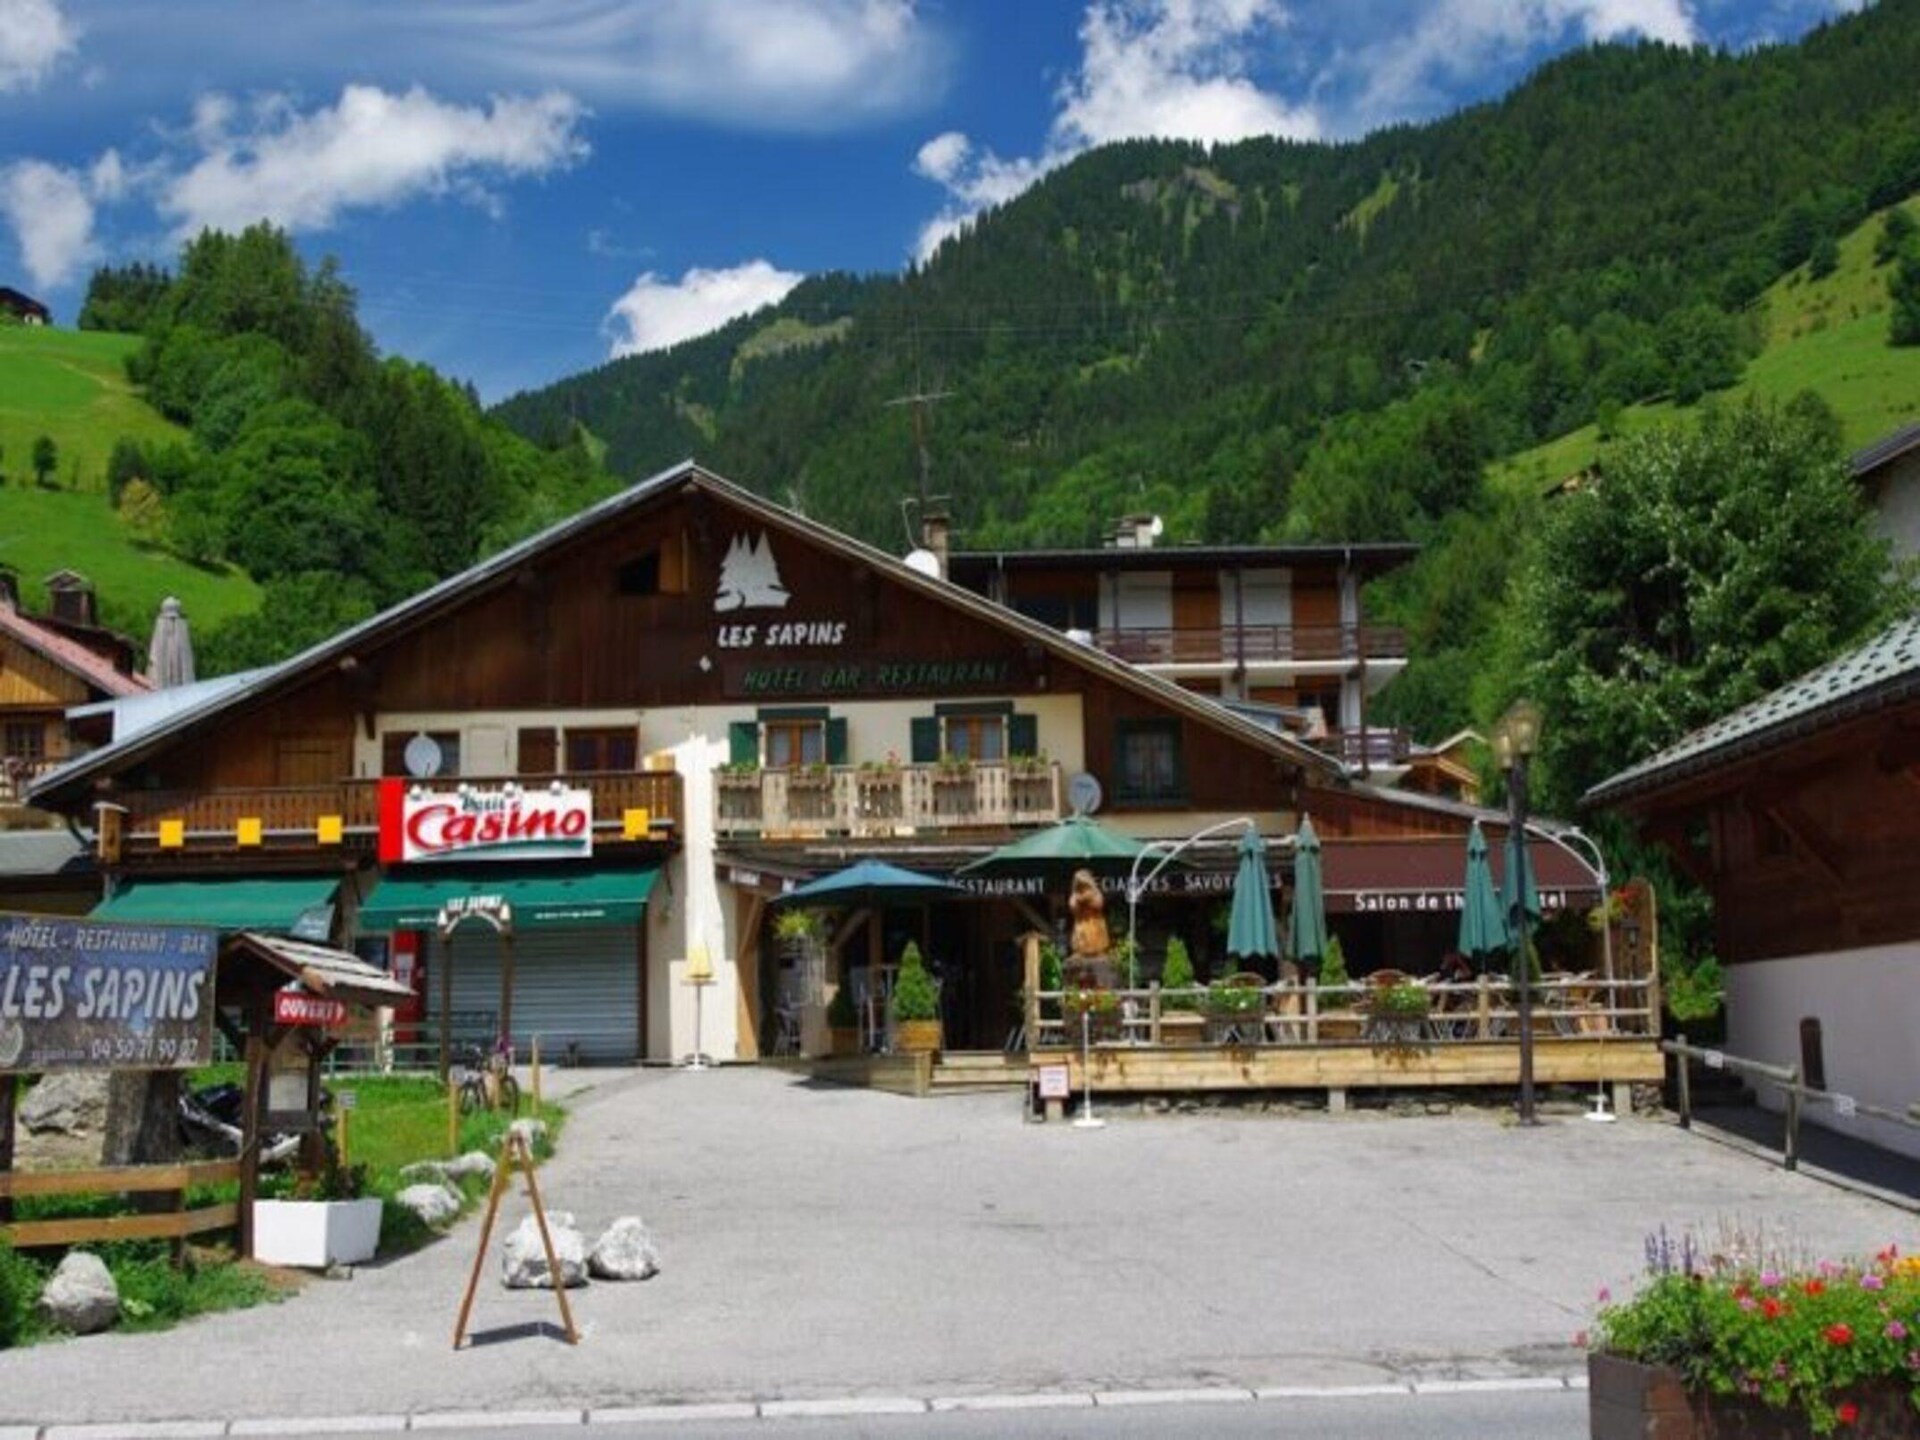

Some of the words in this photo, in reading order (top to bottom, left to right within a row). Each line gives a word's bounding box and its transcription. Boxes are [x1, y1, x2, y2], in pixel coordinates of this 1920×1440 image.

[717, 624, 755, 648] LES
[764, 621, 847, 646] SAPINS
[407, 801, 586, 853] Casino
[1355, 892, 1409, 911] Salon
[1417, 890, 1438, 909] de
[1445, 891, 1466, 909] th
[8, 918, 57, 949] HÔTEL
[74, 929, 166, 952] RESTAURANT
[2, 964, 71, 1019] LES
[76, 968, 206, 1021] SAPINS
[91, 1038, 111, 1060] 04
[115, 1038, 134, 1059] 50
